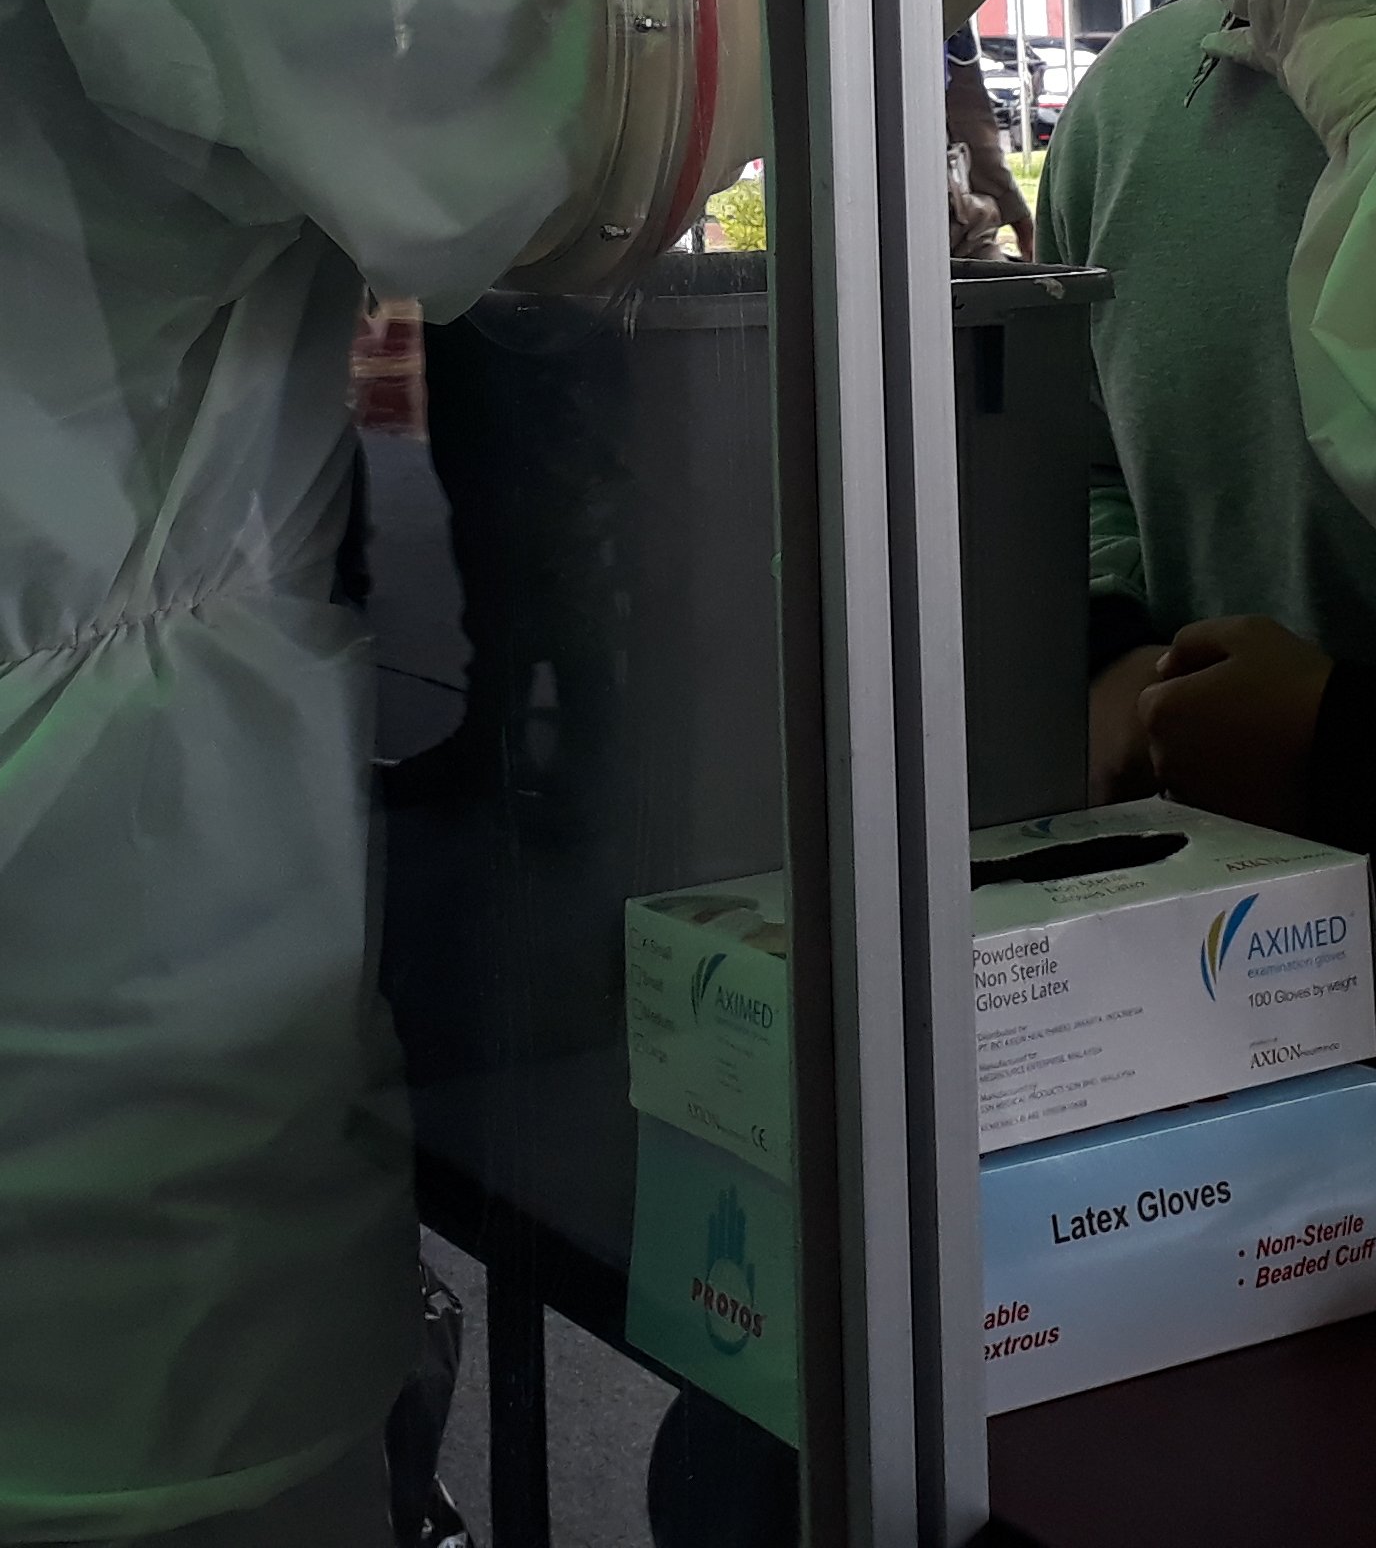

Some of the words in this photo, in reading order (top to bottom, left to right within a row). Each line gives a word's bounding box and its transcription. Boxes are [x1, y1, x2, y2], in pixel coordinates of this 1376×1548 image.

[972, 935, 1050, 968] Powdered
[1248, 915, 1347, 960] AXIMED
[975, 967, 1008, 991] Non
[1010, 957, 1058, 985] Sterile
[976, 987, 1028, 1013] Gloves
[1031, 978, 1070, 1001] Latex
[1248, 989, 1272, 1009] 100
[1274, 985, 1312, 1004] Gloves
[1313, 983, 1325, 998] by
[1327, 975, 1358, 994] weight
[715, 985, 774, 1029] AXIMED
[1250, 1043, 1302, 1069] AXION
[1051, 1203, 1129, 1244] Latex
[1136, 1180, 1232, 1223] Gloves
[1255, 1214, 1364, 1260] Non-Sterile
[1254, 1254, 1330, 1289] Beaded
[1335, 1237, 1376, 1267] Cuff
[691, 1277, 764, 1338] PROTOS
